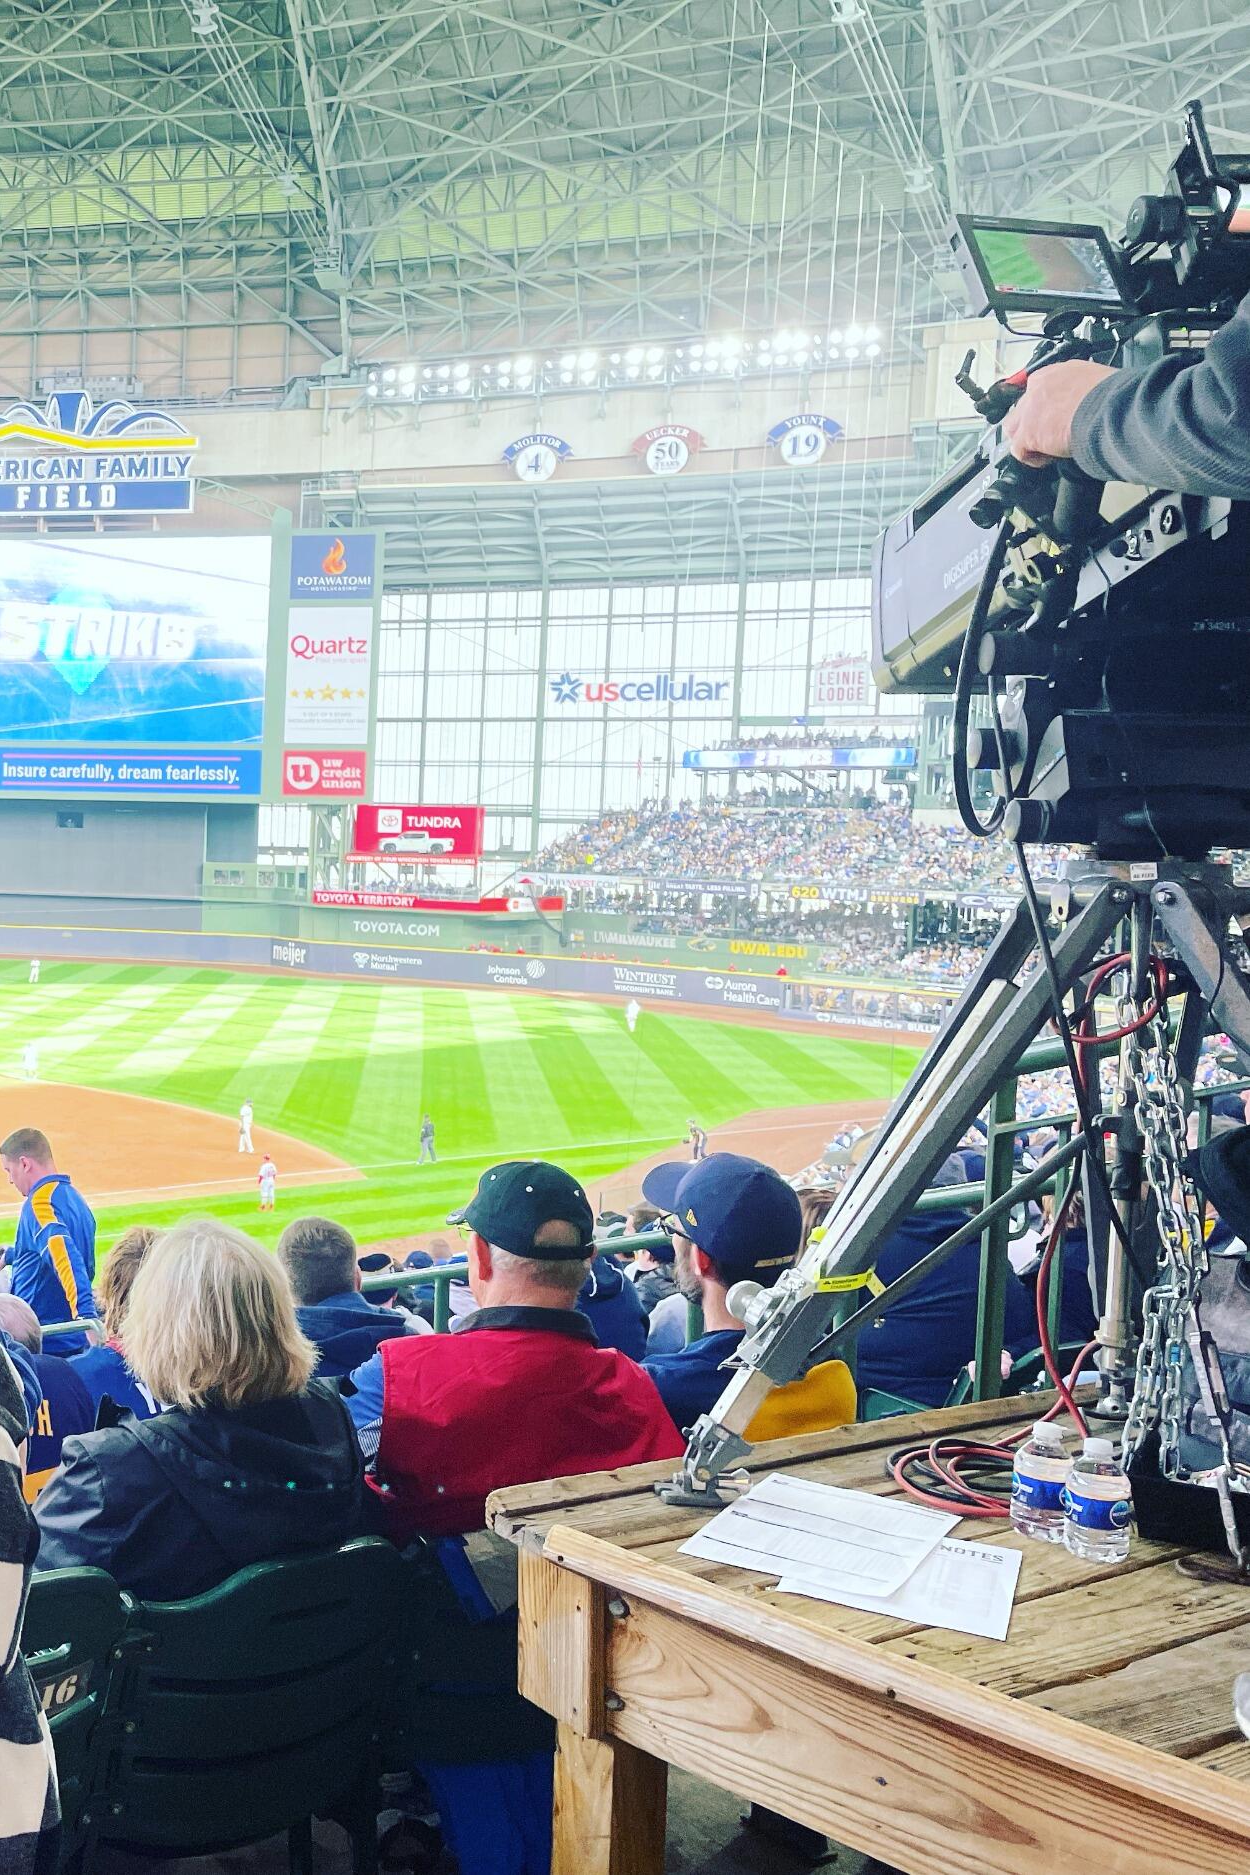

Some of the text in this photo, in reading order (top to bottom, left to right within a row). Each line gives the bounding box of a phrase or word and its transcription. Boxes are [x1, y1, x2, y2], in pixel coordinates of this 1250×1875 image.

[785, 415, 827, 428] YOUNT
[645, 425, 690, 441] UECKER
[513, 434, 562, 450] MOLITOR
[788, 433, 820, 457] 19
[654, 441, 679, 460] 50
[95, 456, 192, 479] FAMILY
[527, 453, 541, 473] 4
[16, 484, 117, 509] FIELD
[297, 576, 372, 586] POTAWATOMI
[290, 634, 368, 660] Quartz
[819, 671, 865, 686] LEINIE
[818, 687, 864, 701] LODGE
[321, 759, 343, 768] uw
[2, 762, 240, 785] Insure carefully, dream fearlessly.
[321, 767, 362, 778] credit
[321, 778, 362, 789] union
[406, 815, 462, 829] TUNDRA
[316, 892, 415, 907] TOYOTA TERRITORY
[791, 886, 868, 901] 620 WTMJ
[353, 919, 440, 937] TOYOTA.COM
[272, 942, 306, 967] meijer
[728, 939, 808, 959] UWM.EDU
[370, 953, 423, 965] Northwestern
[370, 961, 398, 972] Mutual
[486, 964, 521, 976] Johnson
[613, 967, 677, 986] WINTRUST
[493, 974, 528, 985] Controls
[724, 979, 757, 993] Aurora
[723, 990, 781, 1007] Health Care
[940, 1544, 1004, 1562] NOTES
[41, 1674, 78, 1710] 16
